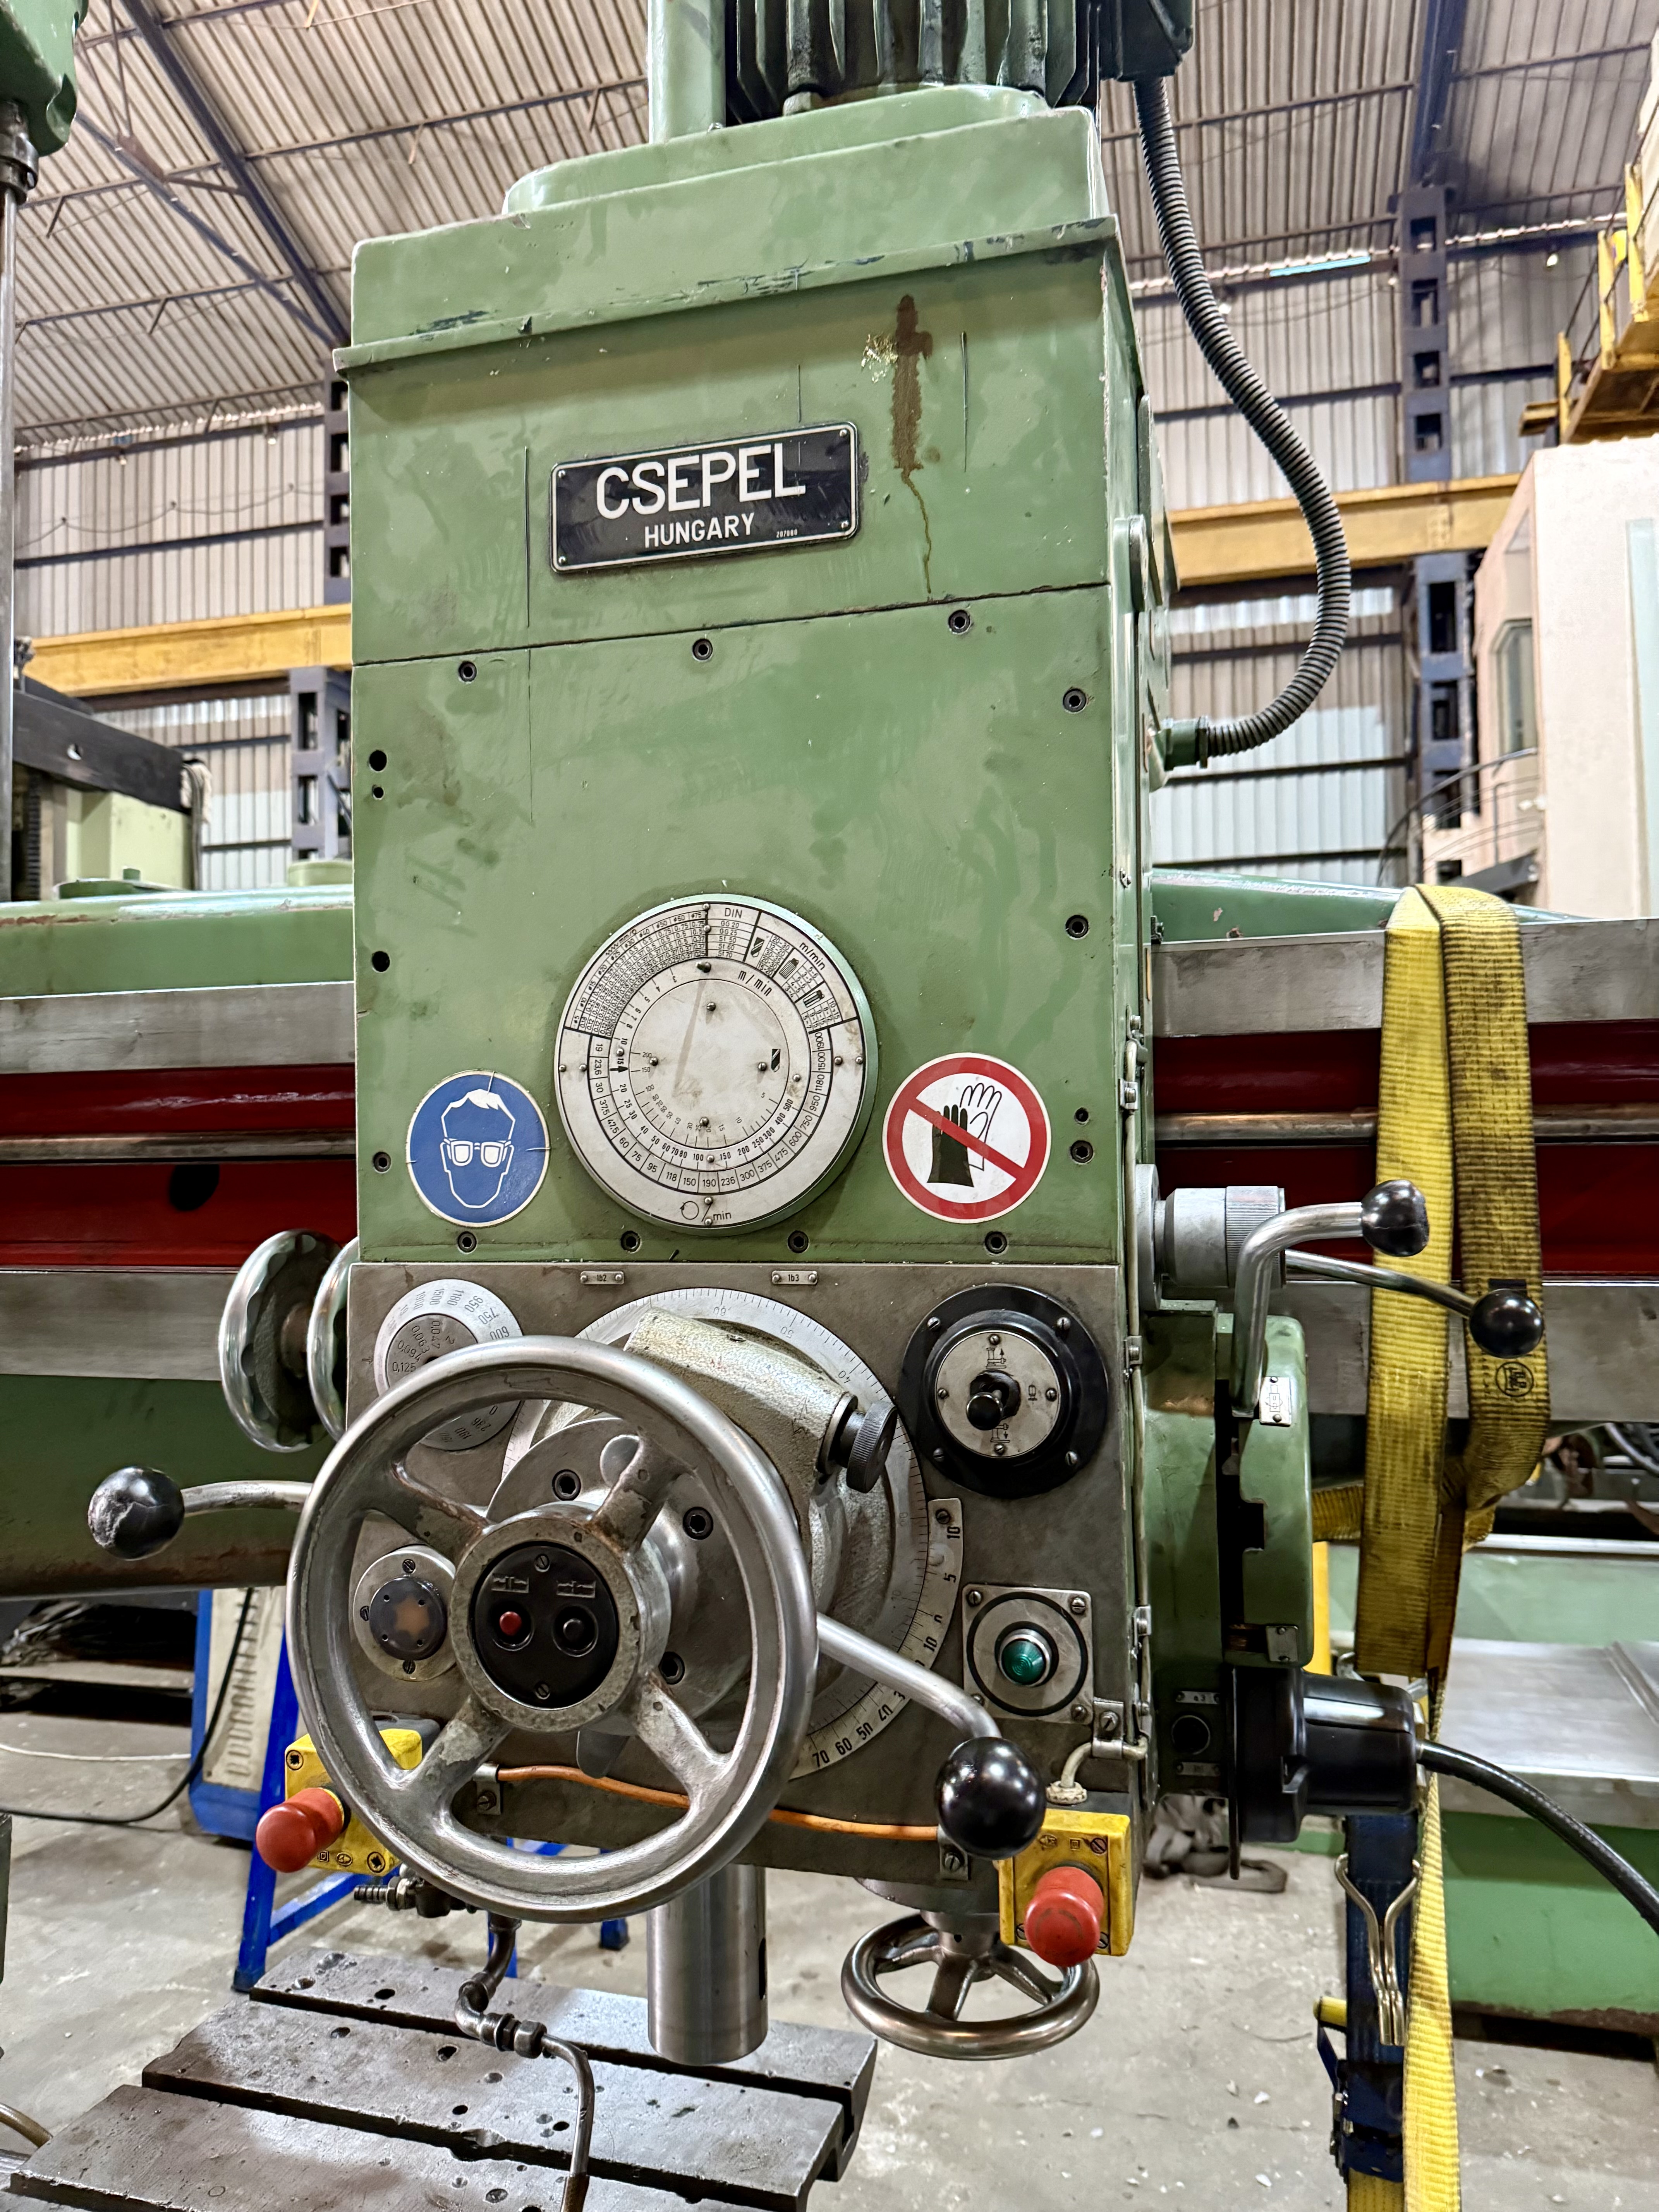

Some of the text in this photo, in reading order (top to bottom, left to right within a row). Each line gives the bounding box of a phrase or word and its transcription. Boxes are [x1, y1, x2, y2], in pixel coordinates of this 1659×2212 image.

[596, 443, 805, 520] CSEPEL
[645, 513, 755, 548] HUNGARY
[725, 908, 742, 919] DIN
[769, 943, 785, 957] 12-20
[799, 942, 825, 970] m/min
[815, 1032, 824, 1049] 1900
[596, 1082, 604, 1093] 30
[815, 1074, 825, 1091] 1180
[809, 1095, 820, 1111] 950
[620, 1084, 627, 1092] 20
[624, 1099, 632, 1108] 25
[629, 1110, 637, 1120] 30
[640, 1125, 649, 1134] 40
[651, 1135, 660, 1145] 50
[662, 1143, 670, 1152] 60
[720, 1152, 731, 1160] 150
[737, 1146, 750, 1156] 200
[752, 1137, 764, 1148] 250
[763, 1127, 775, 1140] 300
[775, 1113, 785, 1125] 400
[783, 1099, 793, 1111] 500
[800, 1115, 812, 1130] 750
[619, 1137, 629, 1148] 60
[789, 1131, 802, 1146] 600
[632, 1151, 642, 1161] 75
[775, 1147, 788, 1161] 475
[647, 1163, 658, 1173] 95
[757, 1160, 772, 1173] 375
[666, 1172, 677, 1181] 118
[683, 1177, 696, 1186] 150
[721, 1176, 735, 1186] 236
[740, 1169, 755, 1181] 300
[414, 1291, 426, 1309] 1900
[430, 1288, 445, 1305] 1500
[447, 1290, 464, 1305] 1180
[465, 1296, 483, 1312] 950
[478, 1308, 499, 1324] 750
[780, 1327, 794, 1339] 50
[947, 1526, 960, 1539] 10
[943, 1573, 956, 1583] 5
[923, 1636, 937, 1652] 10
[856, 1723, 873, 1740] 50
[835, 1738, 852, 1755] 60
[812, 1750, 830, 1767] 70
